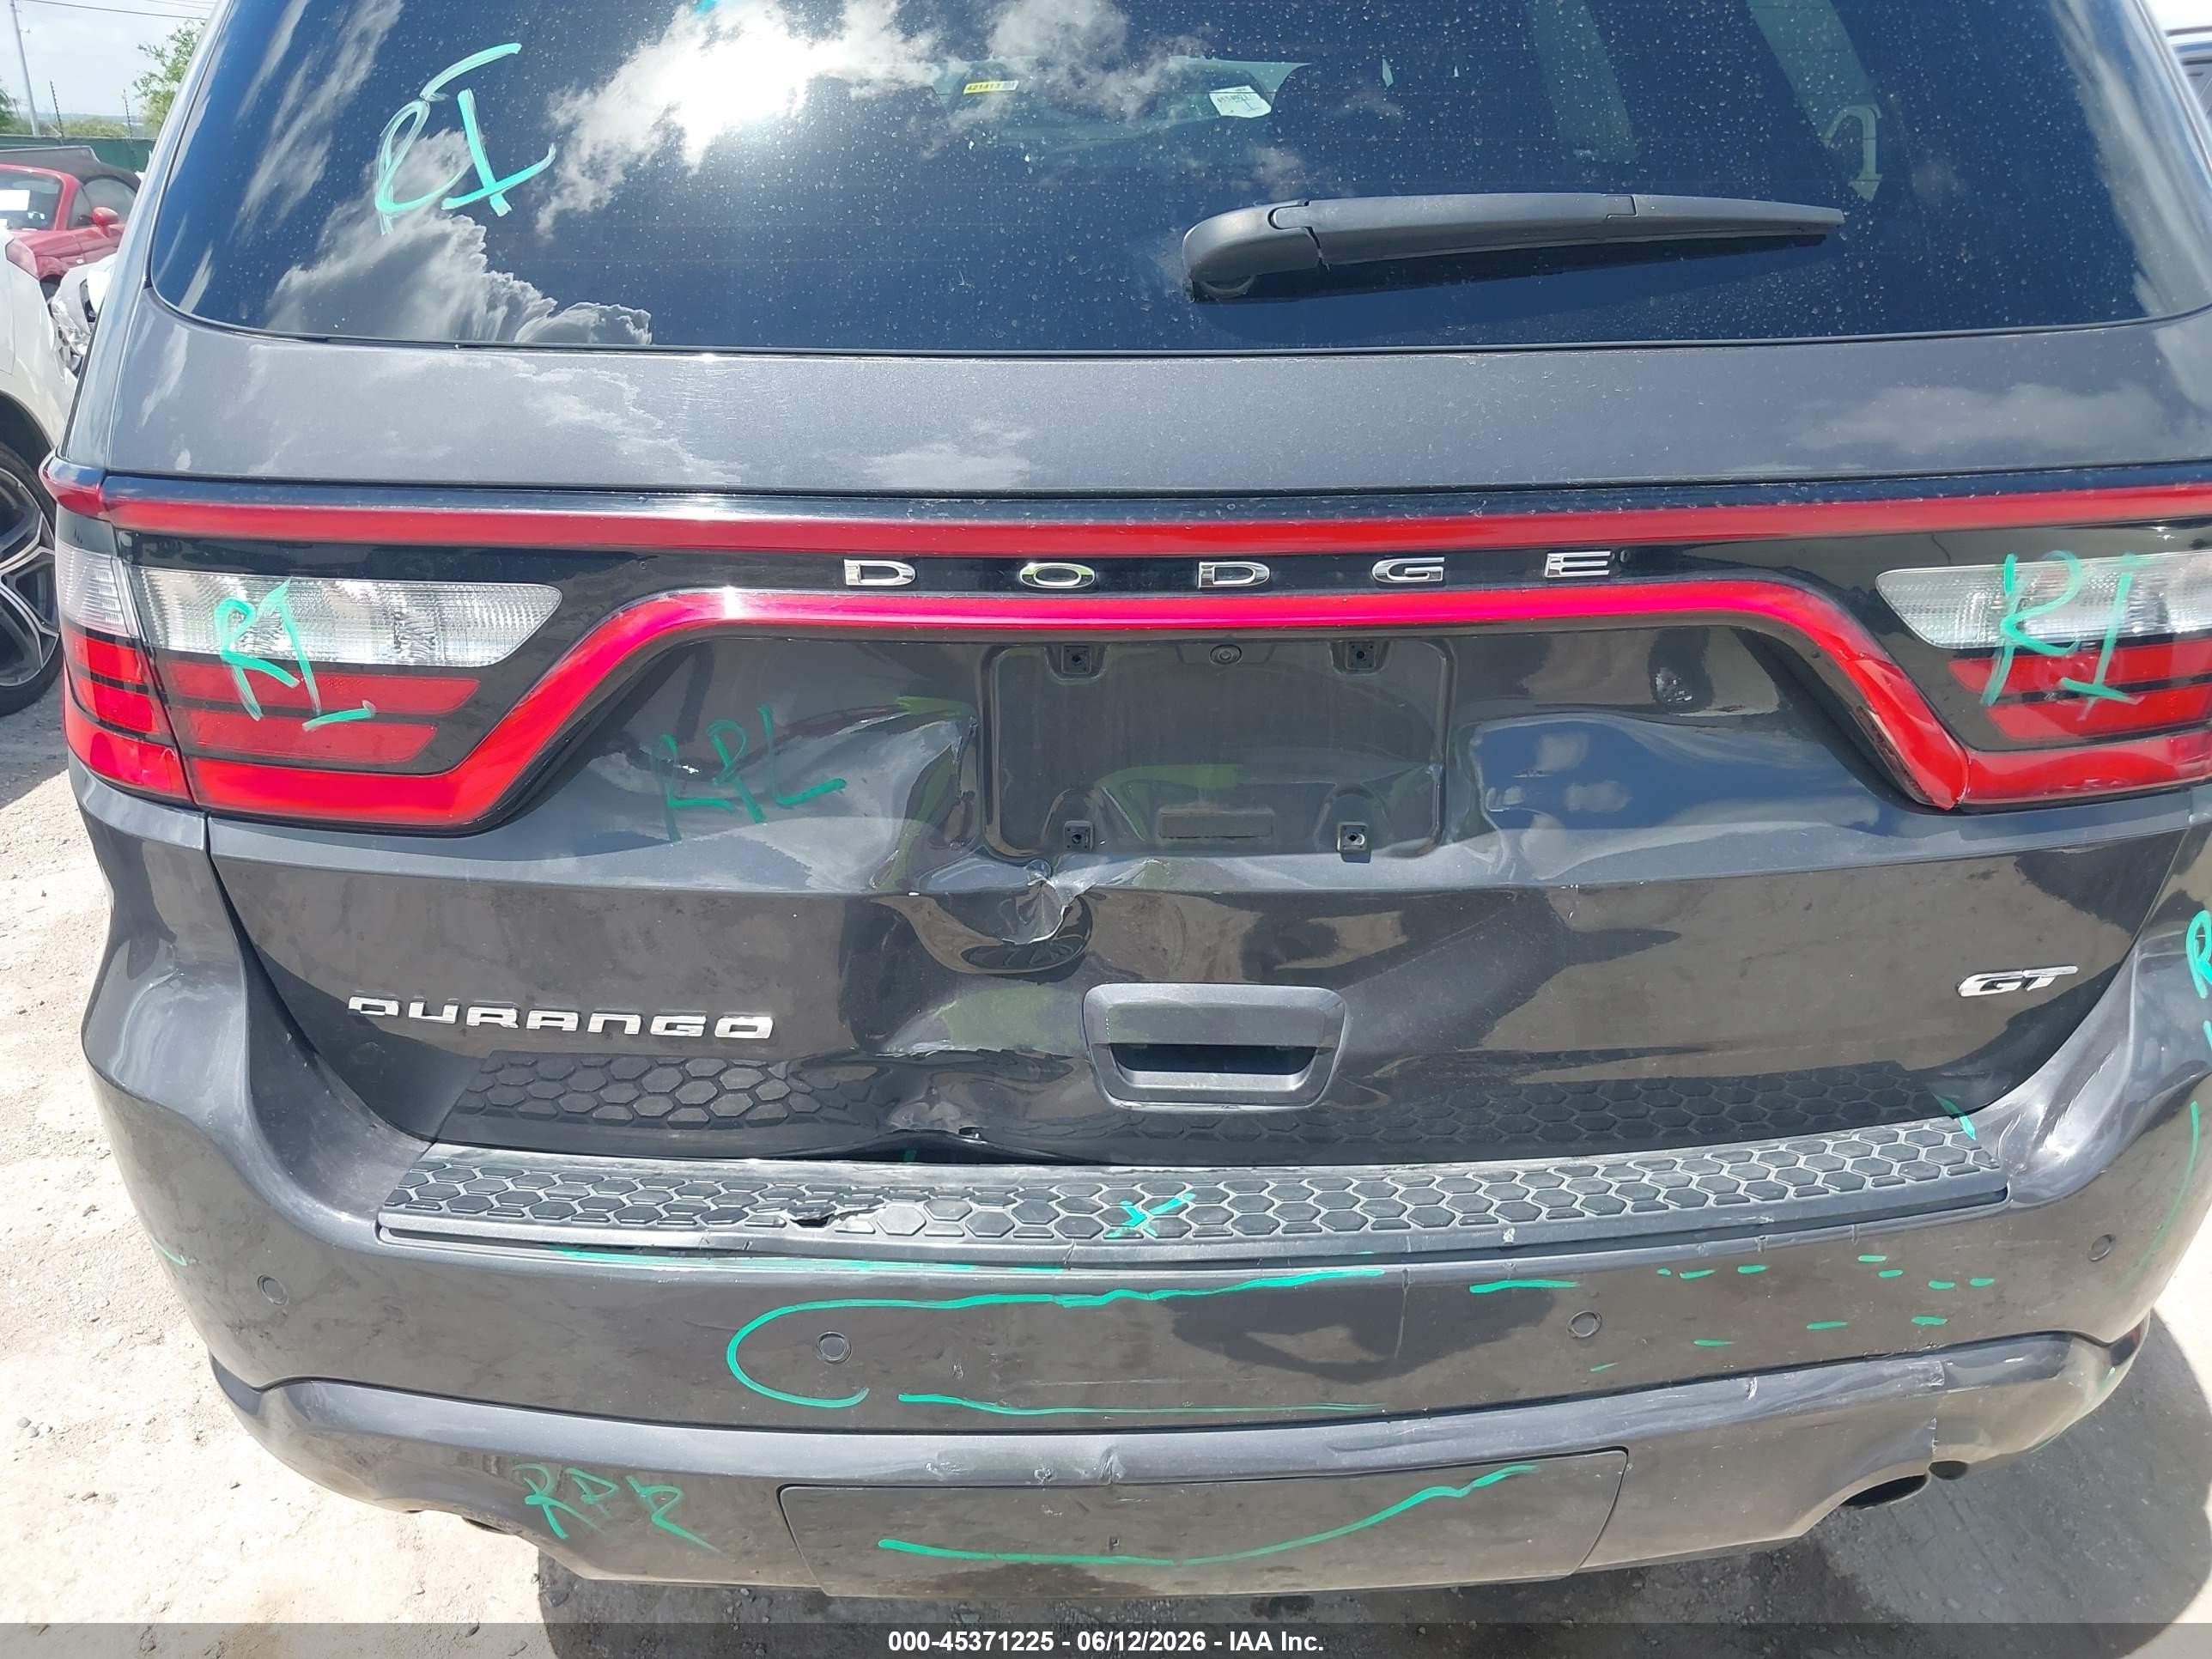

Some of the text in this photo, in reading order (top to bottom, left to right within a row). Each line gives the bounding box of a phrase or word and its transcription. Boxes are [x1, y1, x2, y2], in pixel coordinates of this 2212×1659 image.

[843, 550, 1614, 589] DODGE
[1957, 965, 2079, 997] GT
[347, 995, 774, 1039] DURANGO
